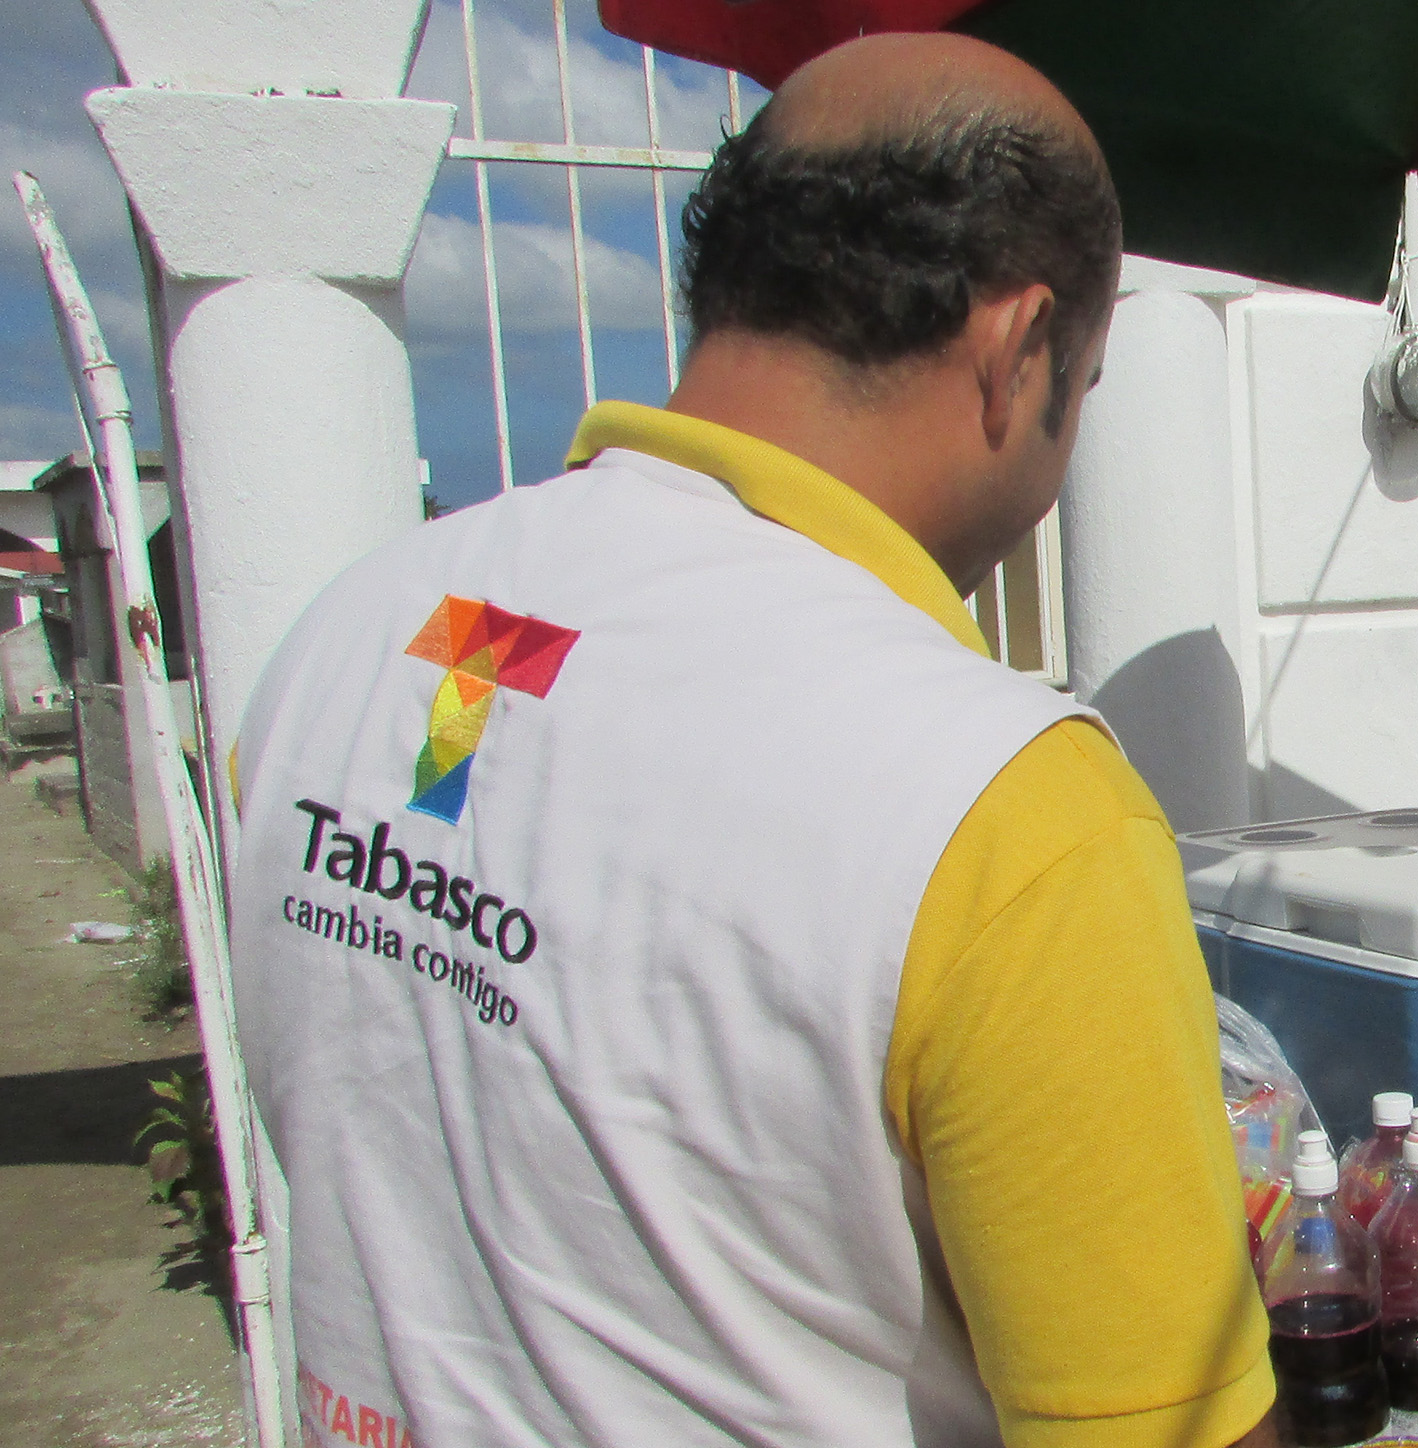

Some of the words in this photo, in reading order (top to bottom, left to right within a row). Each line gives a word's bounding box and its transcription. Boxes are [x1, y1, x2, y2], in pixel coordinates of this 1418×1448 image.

[295, 798, 538, 965] Tabasco
[282, 894, 403, 961] cambia
[412, 942, 520, 1028] contigo
